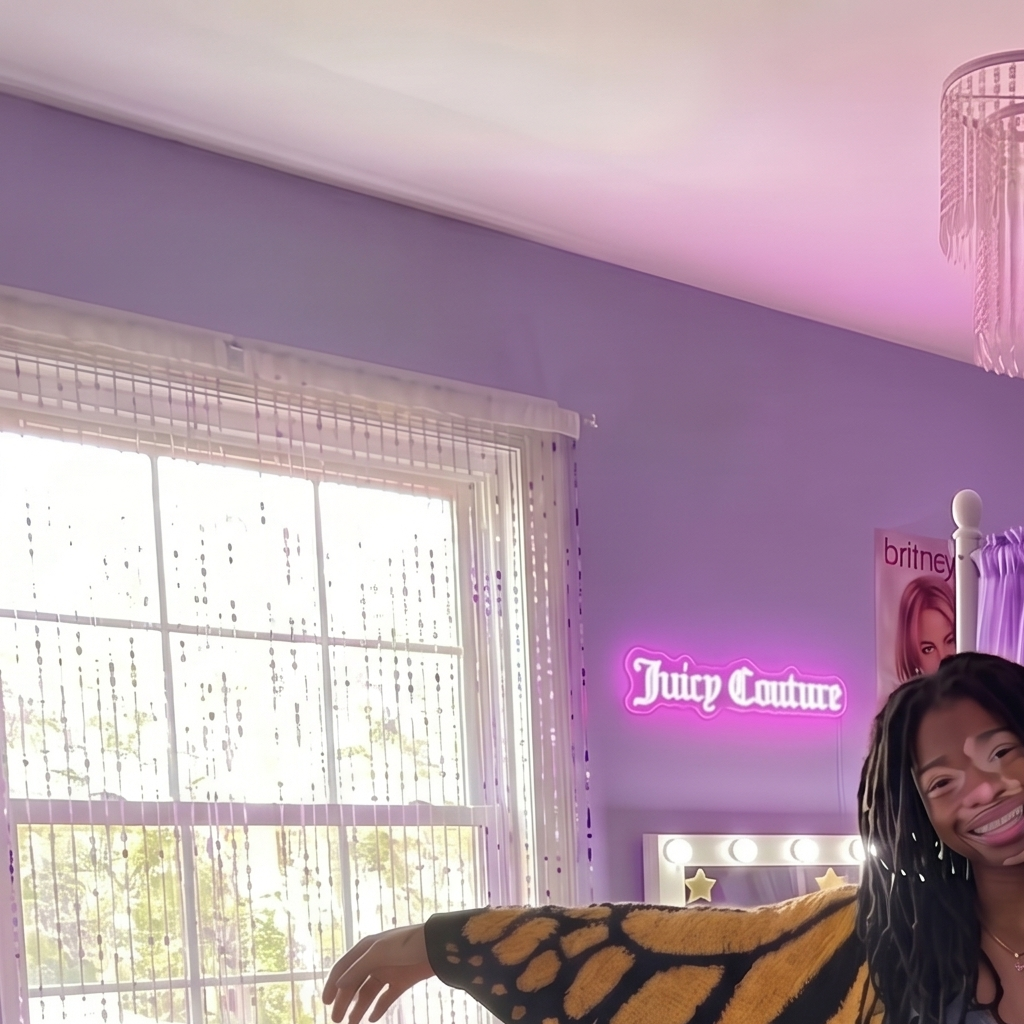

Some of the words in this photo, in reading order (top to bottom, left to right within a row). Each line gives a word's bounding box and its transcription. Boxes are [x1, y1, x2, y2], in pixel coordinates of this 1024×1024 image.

[884, 537, 955, 582] britney
[632, 657, 723, 713] Juicy
[727, 666, 843, 711] Couture
